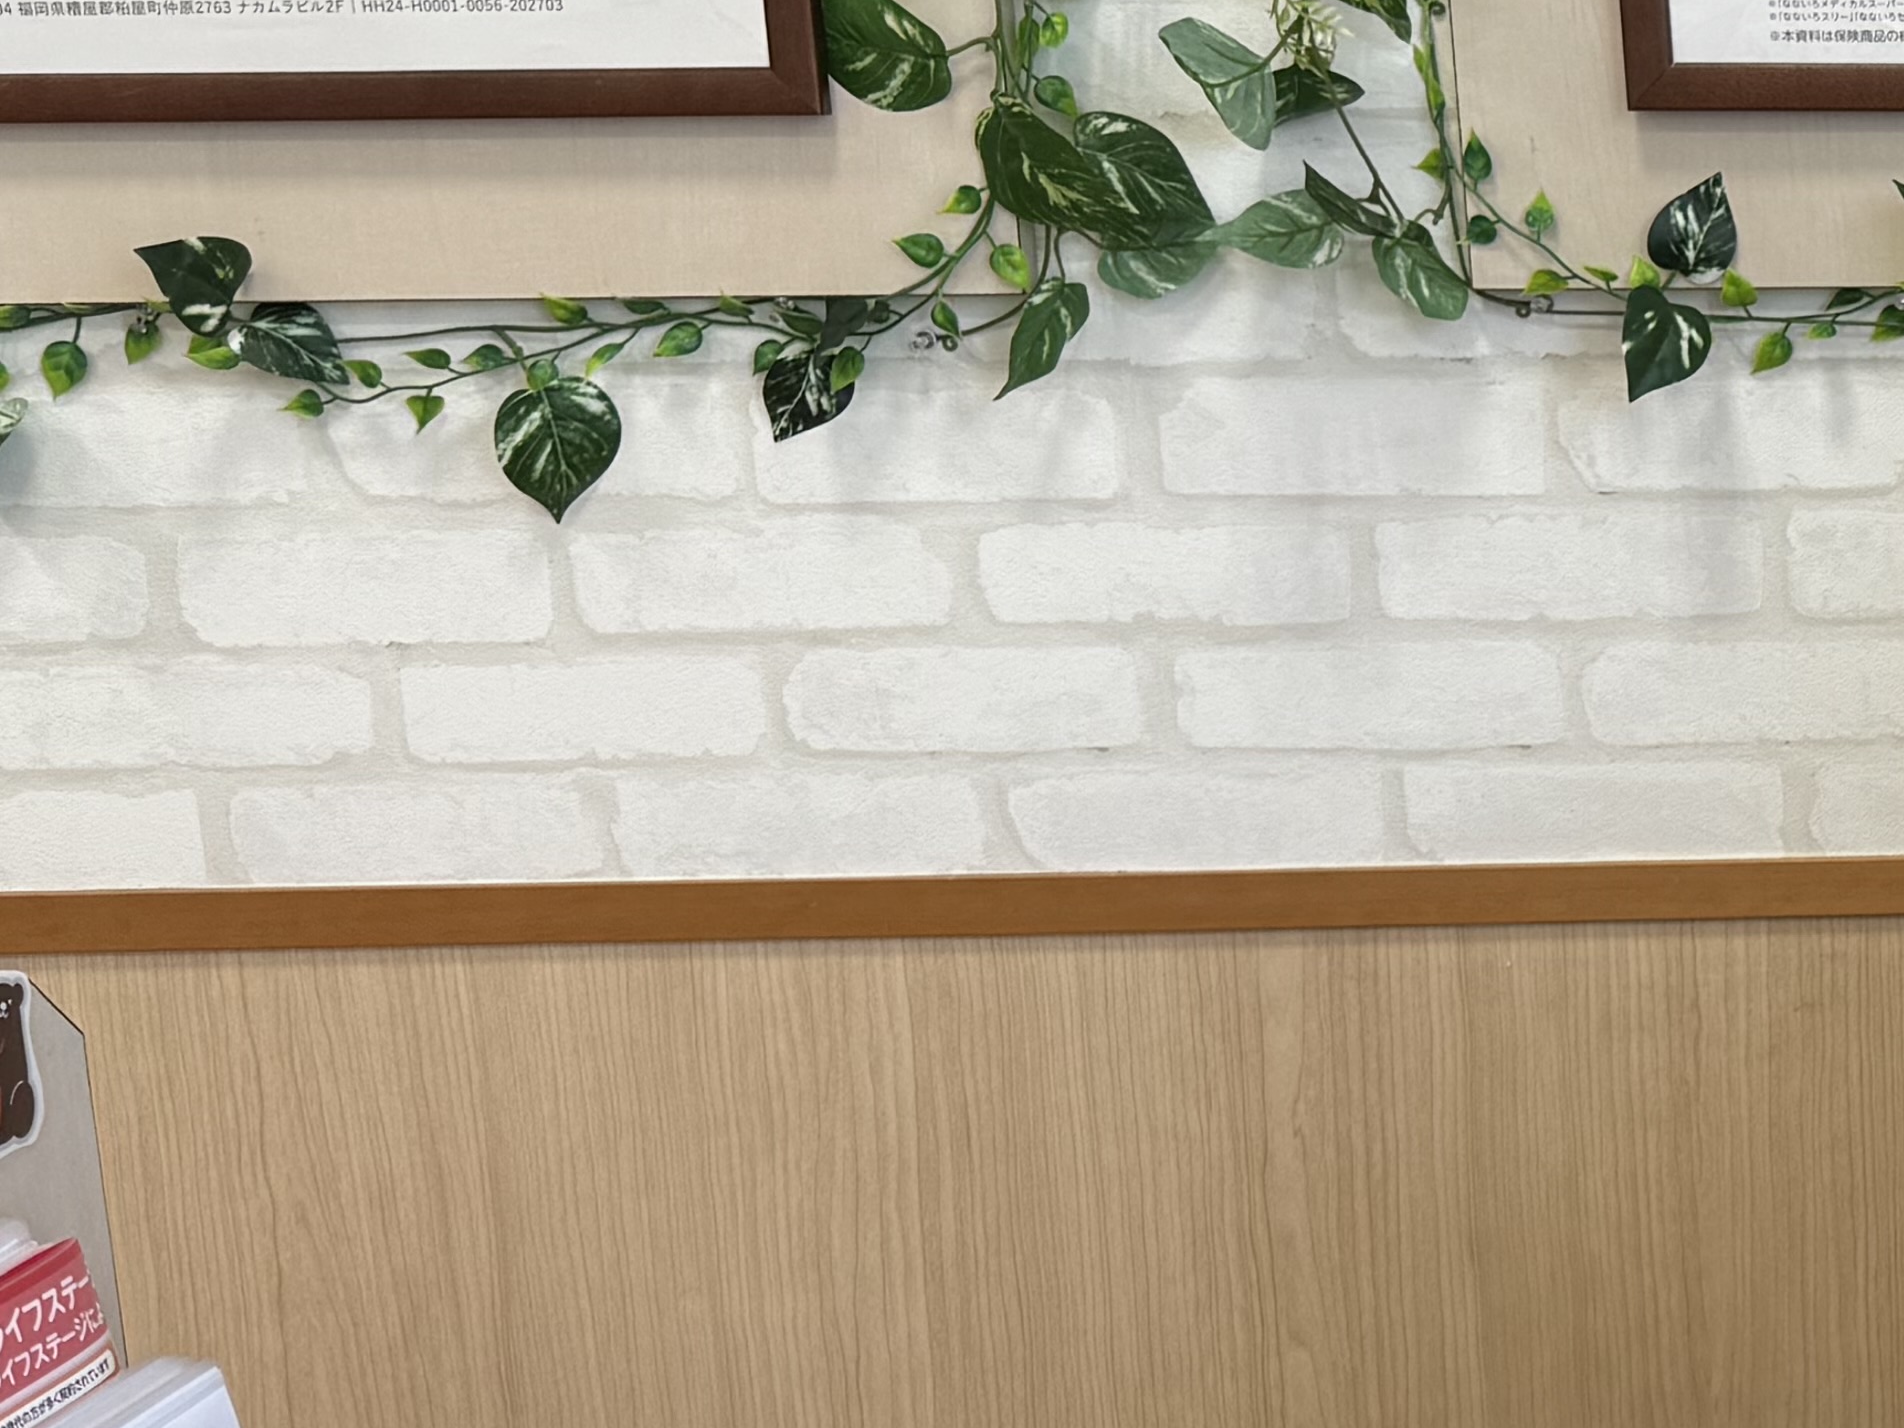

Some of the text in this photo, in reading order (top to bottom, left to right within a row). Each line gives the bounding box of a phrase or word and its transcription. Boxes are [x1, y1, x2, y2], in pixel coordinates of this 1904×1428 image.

[0, 1275, 90, 1352] イフステー
